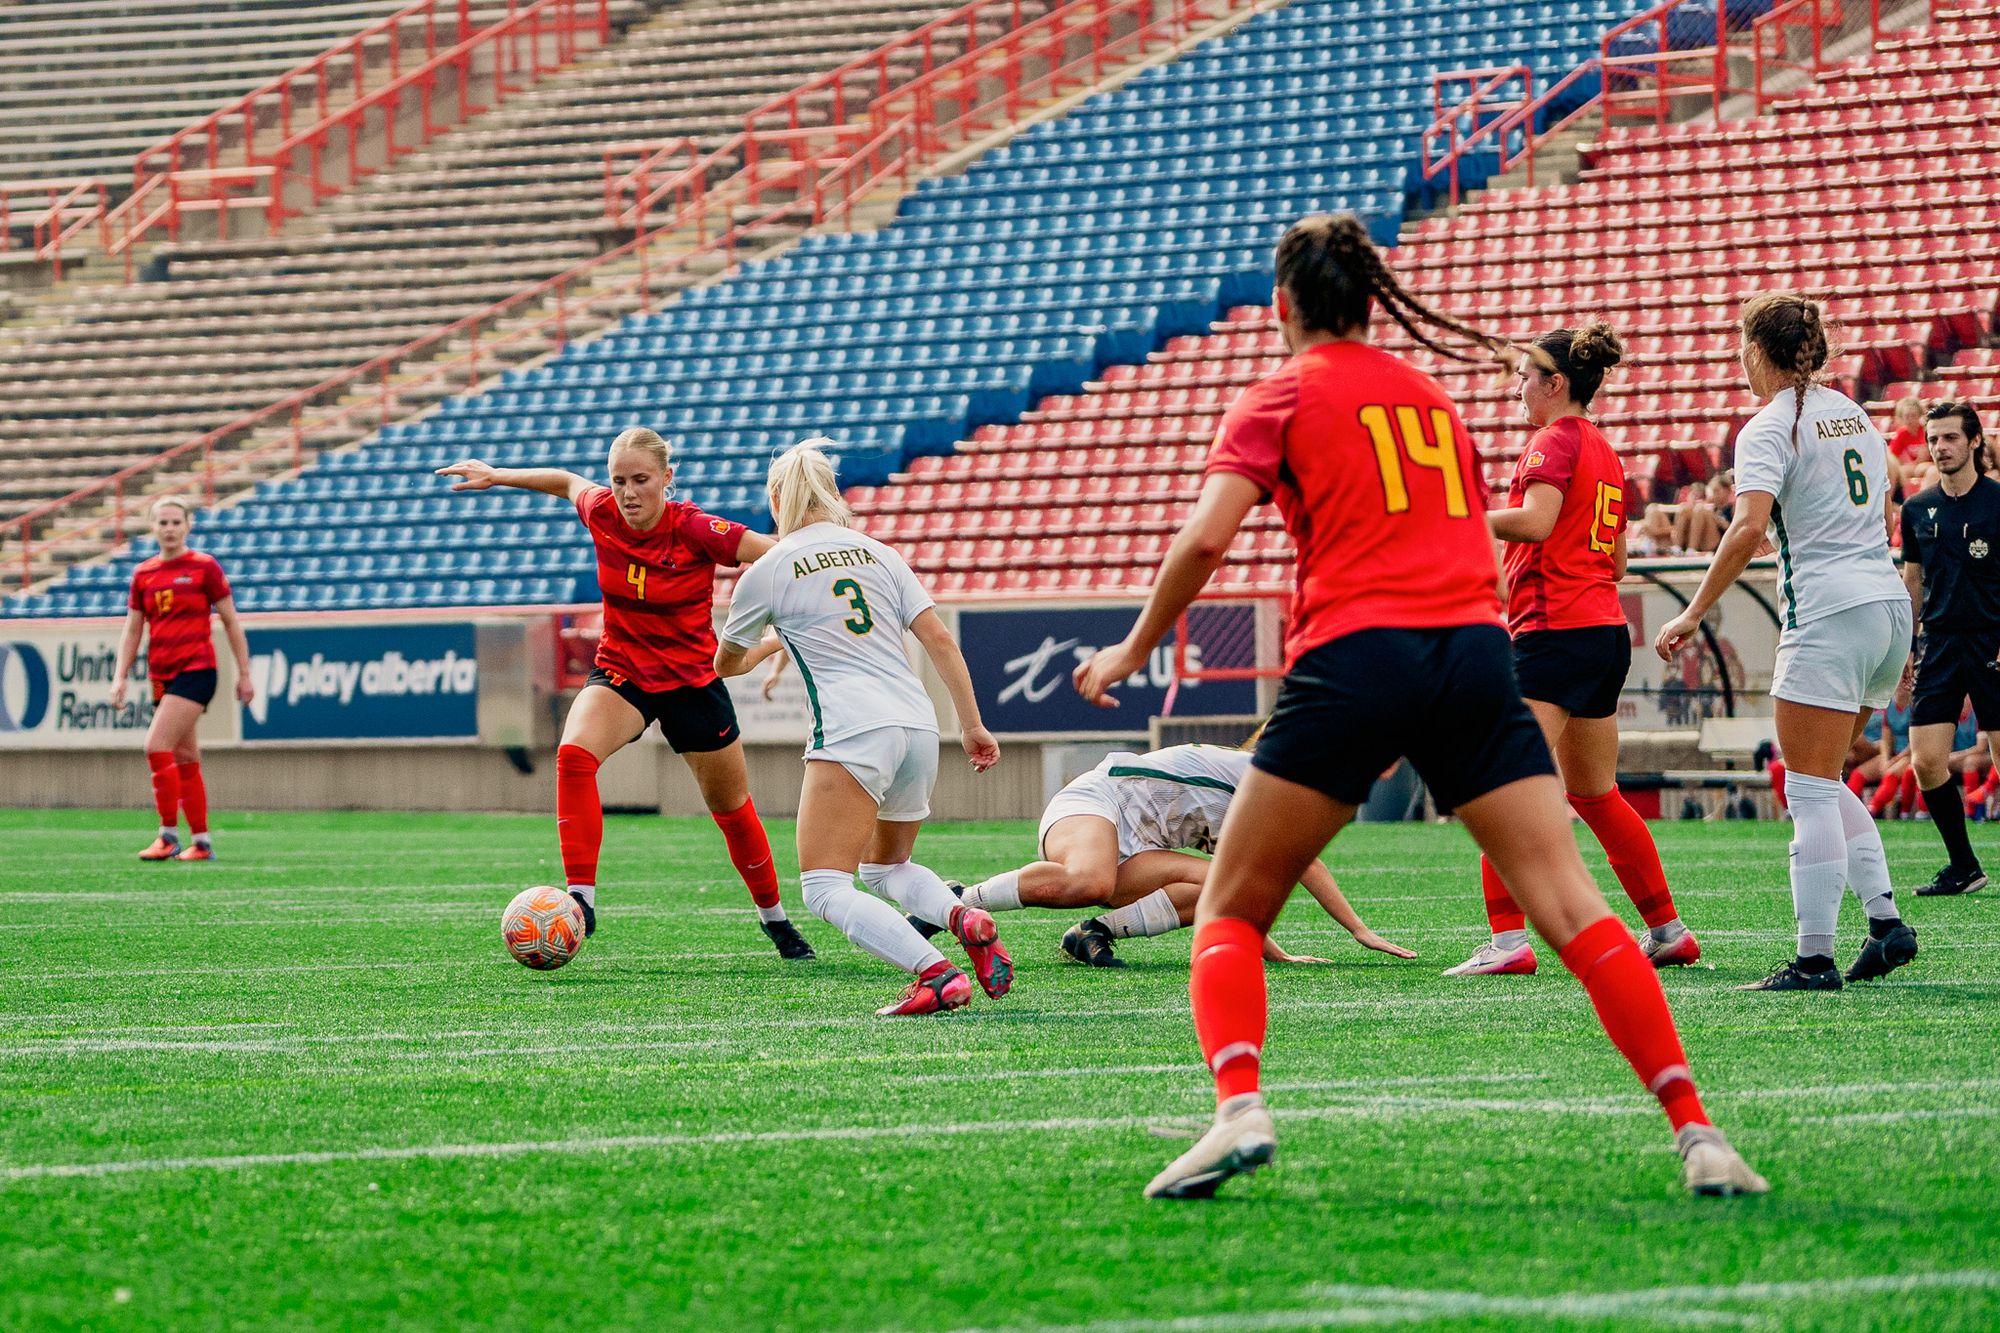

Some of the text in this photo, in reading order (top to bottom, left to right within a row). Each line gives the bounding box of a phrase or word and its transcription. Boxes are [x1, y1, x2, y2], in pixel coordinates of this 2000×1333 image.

[1815, 415, 1867, 440] ALBERTA
[1357, 403, 1470, 519] 14
[1842, 447, 1870, 507] 6
[1589, 479, 1622, 556] 15
[626, 562, 647, 600] 4
[793, 547, 876, 579] ALBERTA
[832, 578, 875, 636] 3
[57, 641, 149, 683] Unitd
[288, 649, 478, 706] play alberta
